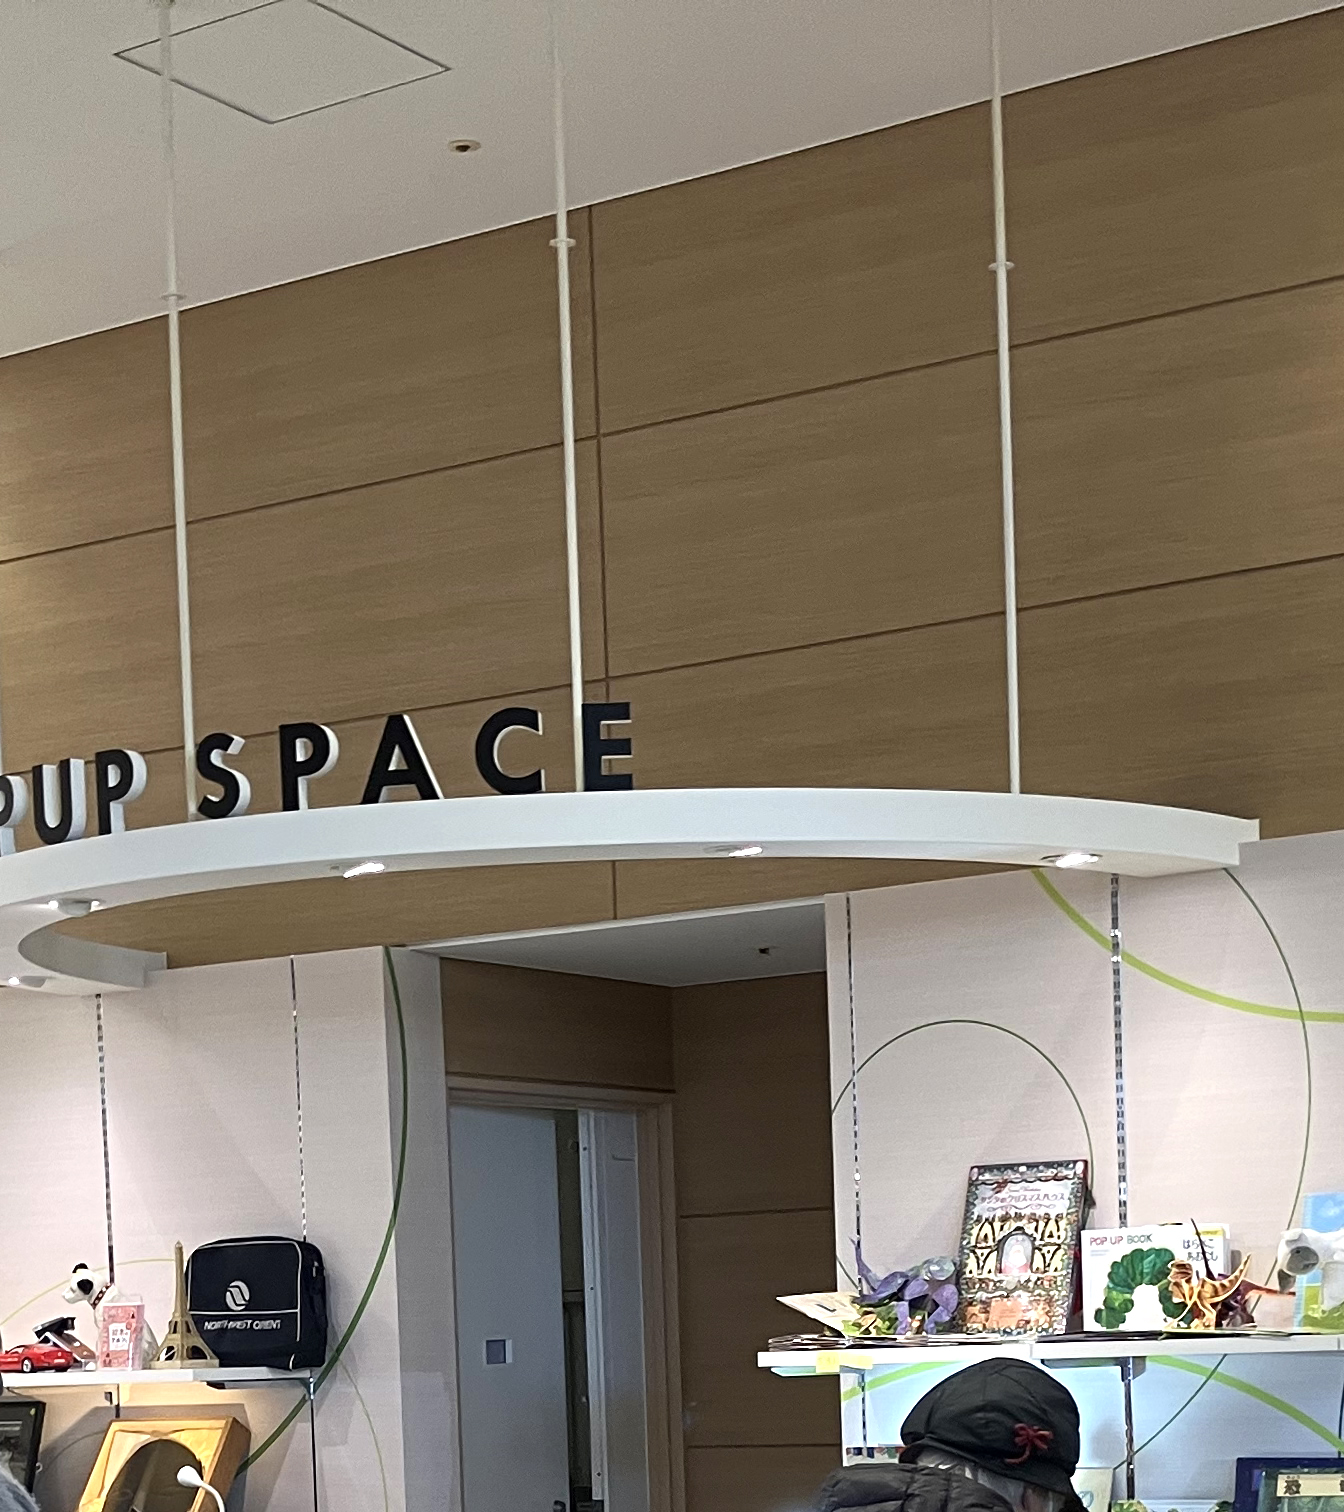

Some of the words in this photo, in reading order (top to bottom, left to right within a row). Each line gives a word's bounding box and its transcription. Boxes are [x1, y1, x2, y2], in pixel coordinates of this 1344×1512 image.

[194, 701, 634, 820] SPACE
[1090, 1236, 1108, 1246] POP
[1110, 1235, 1124, 1245] UP
[1126, 1233, 1153, 1245] BOOK
